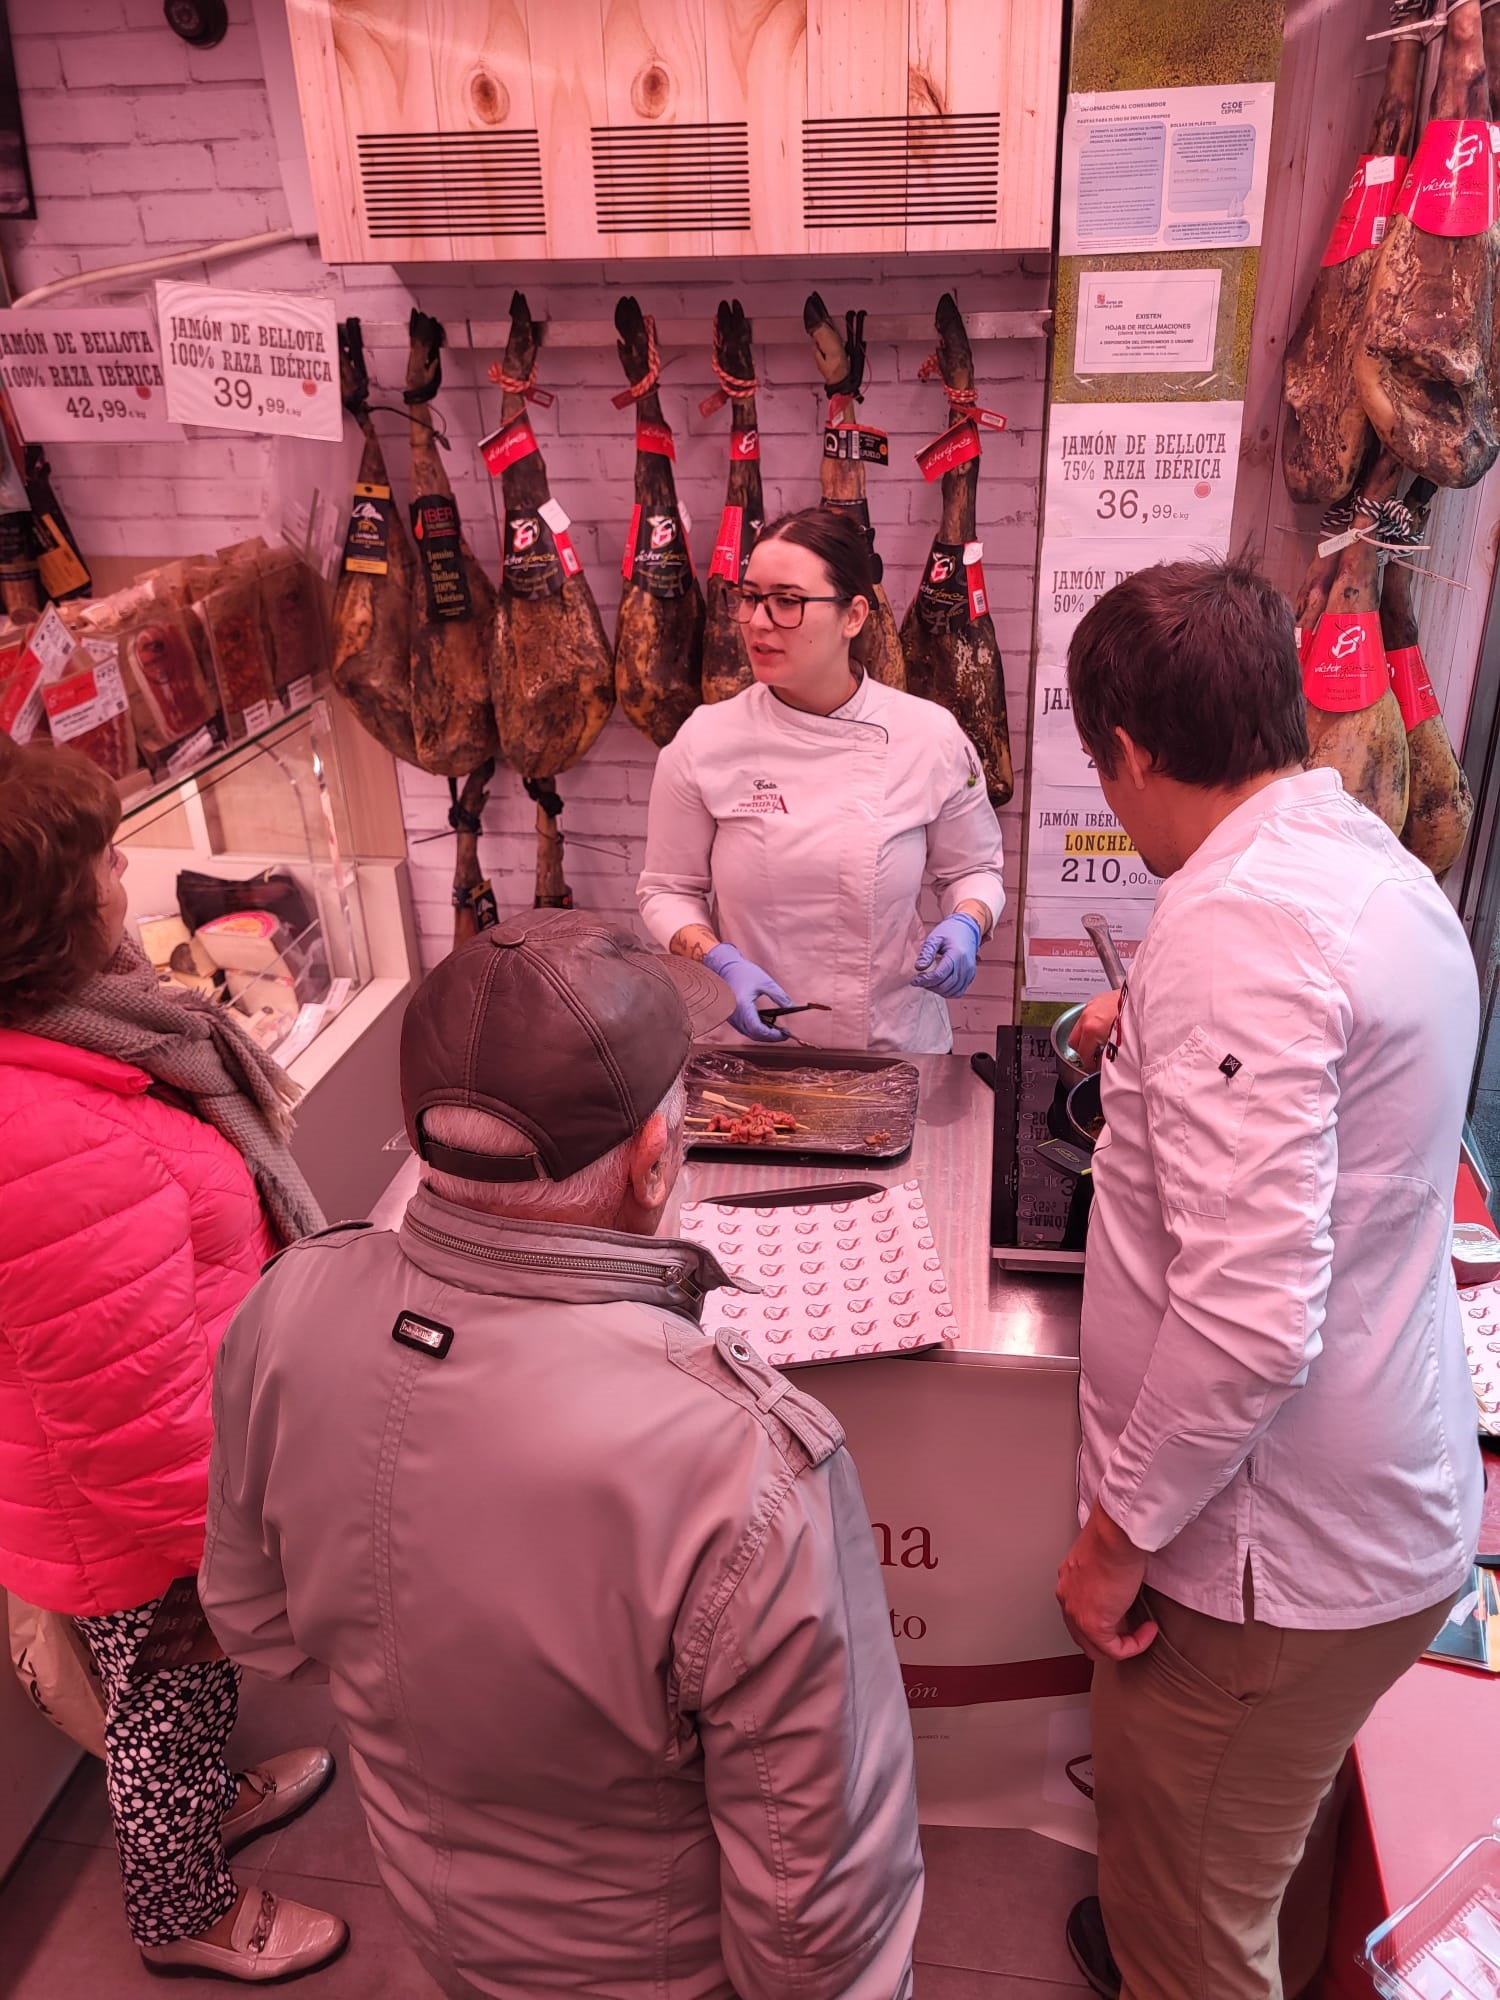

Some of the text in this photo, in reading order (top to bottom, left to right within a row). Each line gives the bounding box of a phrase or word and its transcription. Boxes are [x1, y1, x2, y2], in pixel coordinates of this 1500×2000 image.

[53, 332, 77, 354] DE
[84, 331, 154, 355] BELLOTA
[170, 315, 326, 354] JAMÓN DE BELLOTA
[4, 360, 164, 389] 100% RAZA IBÉRICA
[169, 342, 333, 382] 100% RAZA IBÉRICA
[1061, 431, 1227, 460] JAMÓN DE BELLOTA
[1063, 454, 1222, 481] 75% RAZA IBÉRICA
[1052, 566, 1106, 594] JAMÓN
[1053, 594, 1085, 613] 50%
[1039, 810, 1078, 828] JAMÓN
